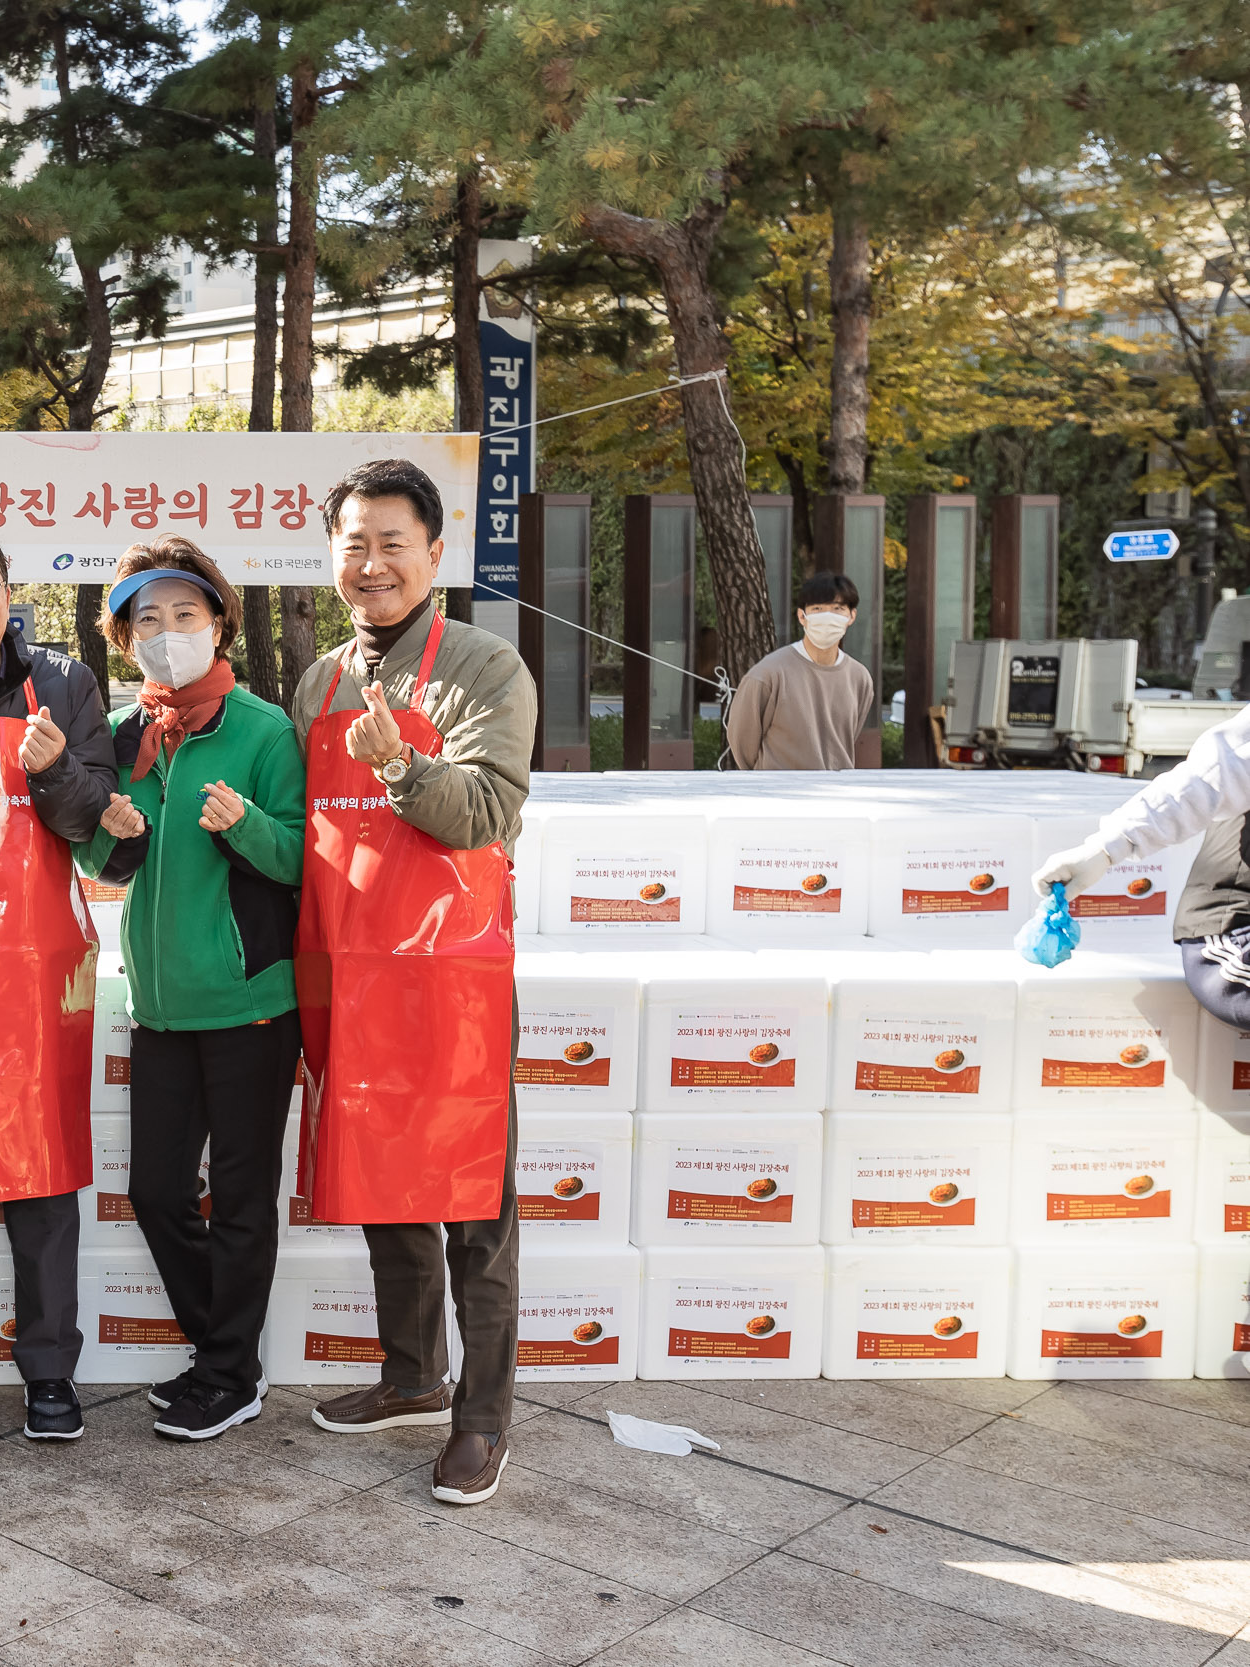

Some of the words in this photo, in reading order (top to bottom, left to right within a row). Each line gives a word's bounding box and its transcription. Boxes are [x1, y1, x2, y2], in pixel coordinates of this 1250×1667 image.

[489, 356, 524, 544] 광진구의회
[74, 481, 208, 530] 사랑의
[228, 481, 324, 530] 김장
[479, 564, 519, 573] GWANGJIN-
[488, 573, 519, 582] COUNCIL
[313, 798, 328, 811] 광진
[330, 797, 359, 810] 사랑의
[532, 1026, 547, 1035] 광진
[549, 1026, 572, 1035] 사랑의
[576, 1027, 606, 1036] 김장축제
[695, 1028, 714, 1036] 제1회
[717, 1028, 732, 1037] 광진
[734, 1028, 757, 1037] 사랑의
[760, 1028, 790, 1037] 김장축제
[522, 1162, 536, 1171] 광진
[539, 1162, 561, 1171] 사랑의
[565, 1162, 595, 1171] 김장축제
[676, 1161, 692, 1169] 2023
[694, 1162, 713, 1170] 제1회
[715, 1162, 730, 1171] 광진
[732, 1163, 755, 1172] 사랑의
[759, 1164, 789, 1173] 김장축제
[694, 1299, 712, 1308] 제1회
[715, 1300, 730, 1309] 광진
[732, 1300, 754, 1309] 사랑의
[758, 1301, 787, 1310] 김장축제
[519, 1308, 538, 1317] 제1회
[541, 1308, 555, 1317] 광진
[558, 1308, 580, 1317] 사랑의
[584, 1307, 613, 1316] 김장축제
